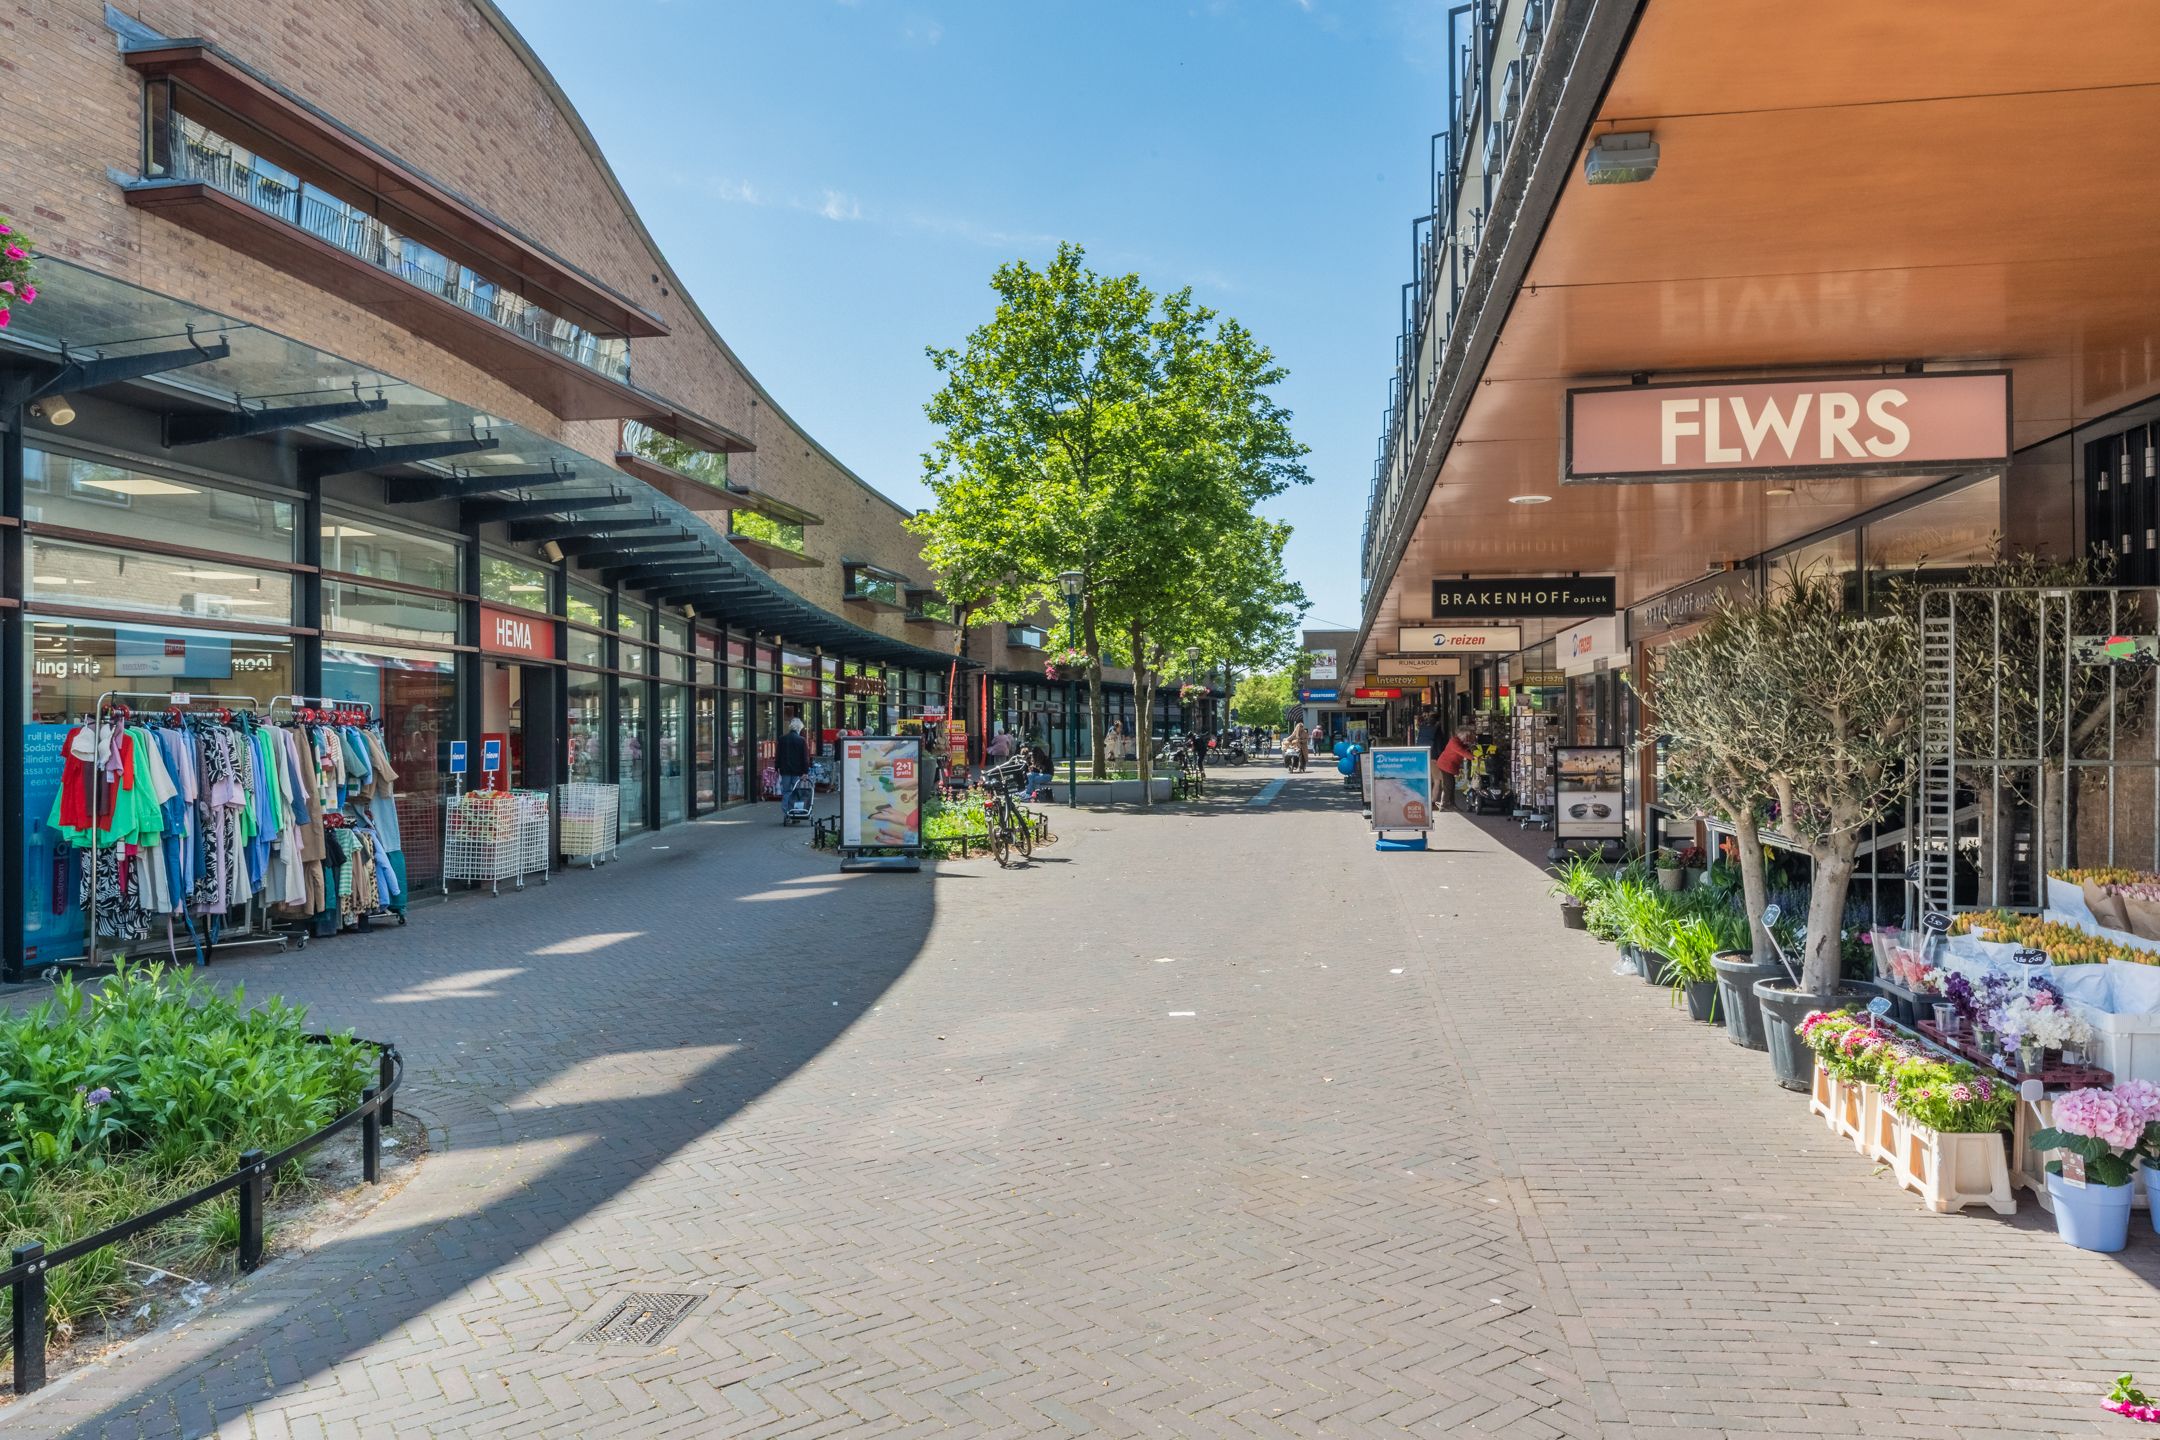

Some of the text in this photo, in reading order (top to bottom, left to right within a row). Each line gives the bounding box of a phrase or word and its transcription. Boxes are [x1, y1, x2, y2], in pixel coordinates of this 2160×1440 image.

[1661, 388, 1910, 466] FLWRS
[1440, 591, 1607, 606] BRAKENHOFF optiek
[496, 617, 532, 650] HEMA
[1432, 633, 1486, 646] D-reizen
[1376, 676, 1417, 685] Intertoys
[24, 767, 43, 775] assa
[896, 762, 912, 771] 2+1
